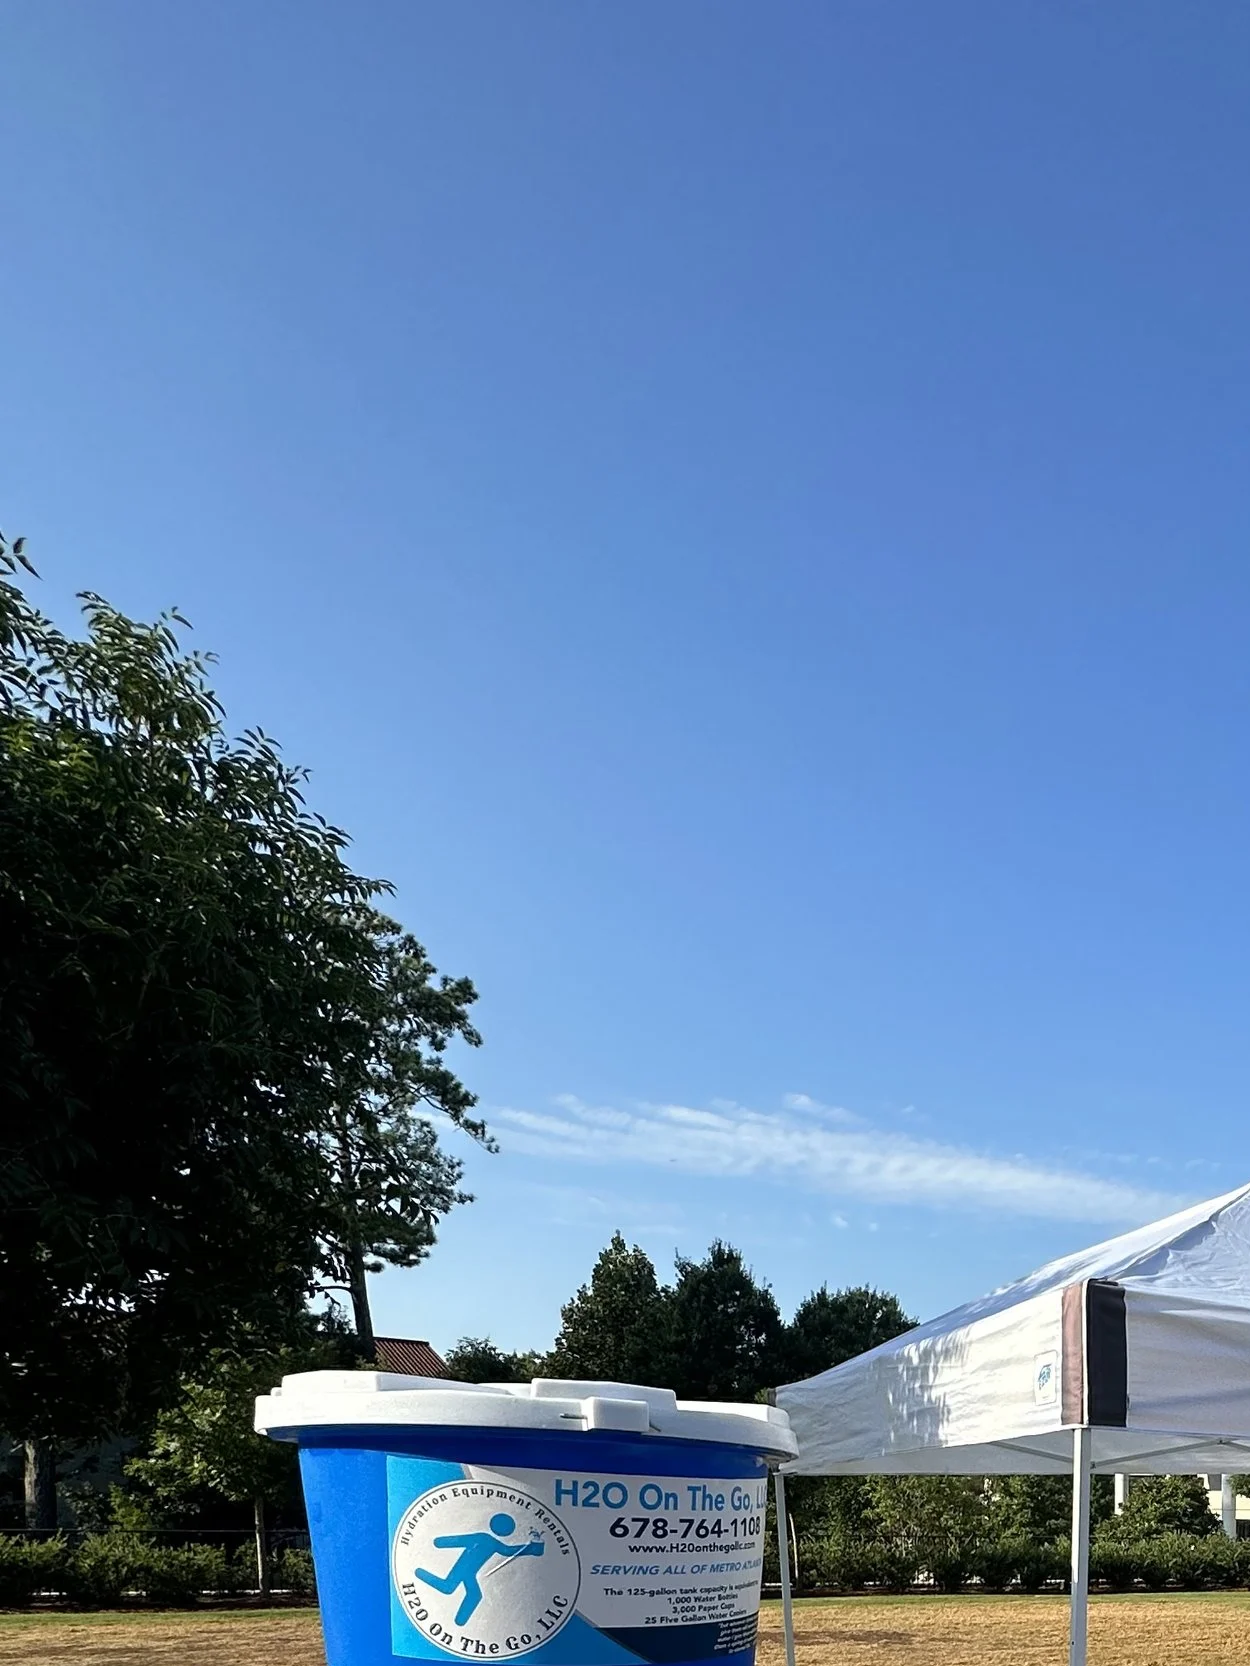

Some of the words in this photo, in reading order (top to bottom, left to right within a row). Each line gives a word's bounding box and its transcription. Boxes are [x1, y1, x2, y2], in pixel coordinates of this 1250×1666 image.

[555, 1479, 629, 1509] H2O
[639, 1483, 679, 1511] On
[687, 1484, 725, 1512] The
[731, 1486, 754, 1514] Go,
[400, 1492, 448, 1546] Hydration
[452, 1485, 532, 1510] Equipment
[535, 1508, 571, 1556] Rentals
[609, 1516, 761, 1539] 678-764-1108
[590, 1564, 660, 1575] SERVING
[663, 1564, 687, 1575] ALL
[690, 1564, 708, 1574] OF
[710, 1562, 741, 1573] METRO
[603, 1588, 623, 1596] The
[627, 1588, 677, 1597] 125-gallon
[680, 1587, 698, 1595] tank
[700, 1585, 728, 1594] capacity
[667, 1597, 692, 1605] 1,000
[718, 1593, 738, 1601] Bottles
[672, 1605, 696, 1615] 3,000
[698, 1604, 719, 1612] Paper
[720, 1602, 735, 1610] Cups
[429, 1623, 453, 1645] On
[460, 1636, 500, 1654] The
[505, 1633, 541, 1651] Go,
[537, 1595, 568, 1631] LLC
[645, 1616, 657, 1624] 25
[660, 1616, 679, 1624] Five
[681, 1614, 706, 1622] Gallon
[708, 1612, 728, 1620] Water
